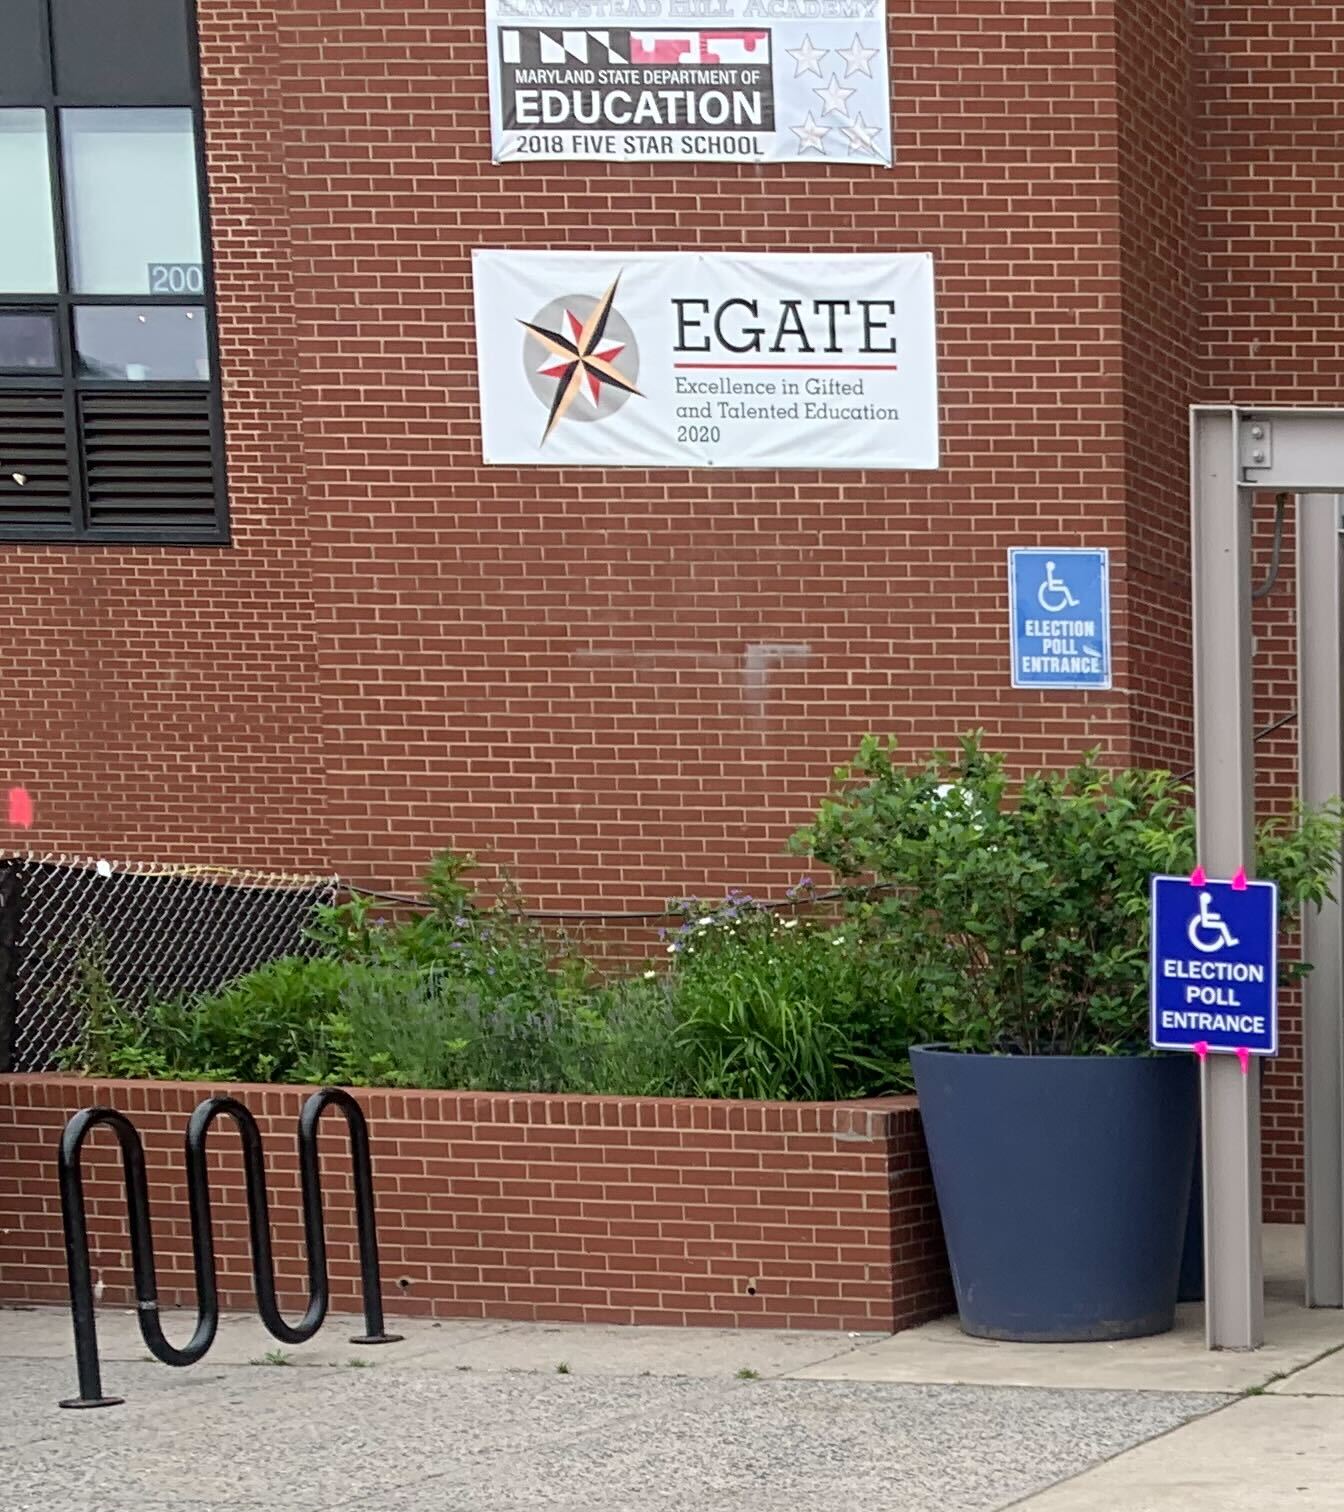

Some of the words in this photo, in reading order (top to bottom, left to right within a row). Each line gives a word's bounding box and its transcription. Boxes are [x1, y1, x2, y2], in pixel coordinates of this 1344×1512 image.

[668, 0, 734, 17] HILL
[743, 0, 880, 18] ACADEMY
[514, 69, 595, 85] MARYLAND
[598, 70, 640, 85] STATE
[643, 70, 738, 86] DEPARTMENT
[743, 70, 761, 86] OF
[514, 89, 763, 125] EDUCATION
[516, 135, 564, 154] 2018
[572, 135, 616, 153] FIVE
[624, 136, 673, 154] STAR
[682, 135, 764, 155] SCHOOL
[152, 266, 203, 292] 200
[671, 297, 897, 354] EGATE
[675, 376, 777, 395] Excellence
[782, 378, 800, 395] in
[804, 378, 865, 396] Gifted
[676, 401, 712, 419] and
[717, 401, 800, 420] Talented
[804, 402, 899, 421] Education
[677, 425, 721, 443] 2020
[1025, 619, 1095, 637] ELECTION
[1042, 638, 1078, 655] POLL
[1021, 656, 1101, 675] ENTRANCE
[1164, 959, 1264, 983] ELECTION
[1186, 986, 1241, 1007] POLL
[1162, 1010, 1266, 1035] ENTRANCE
